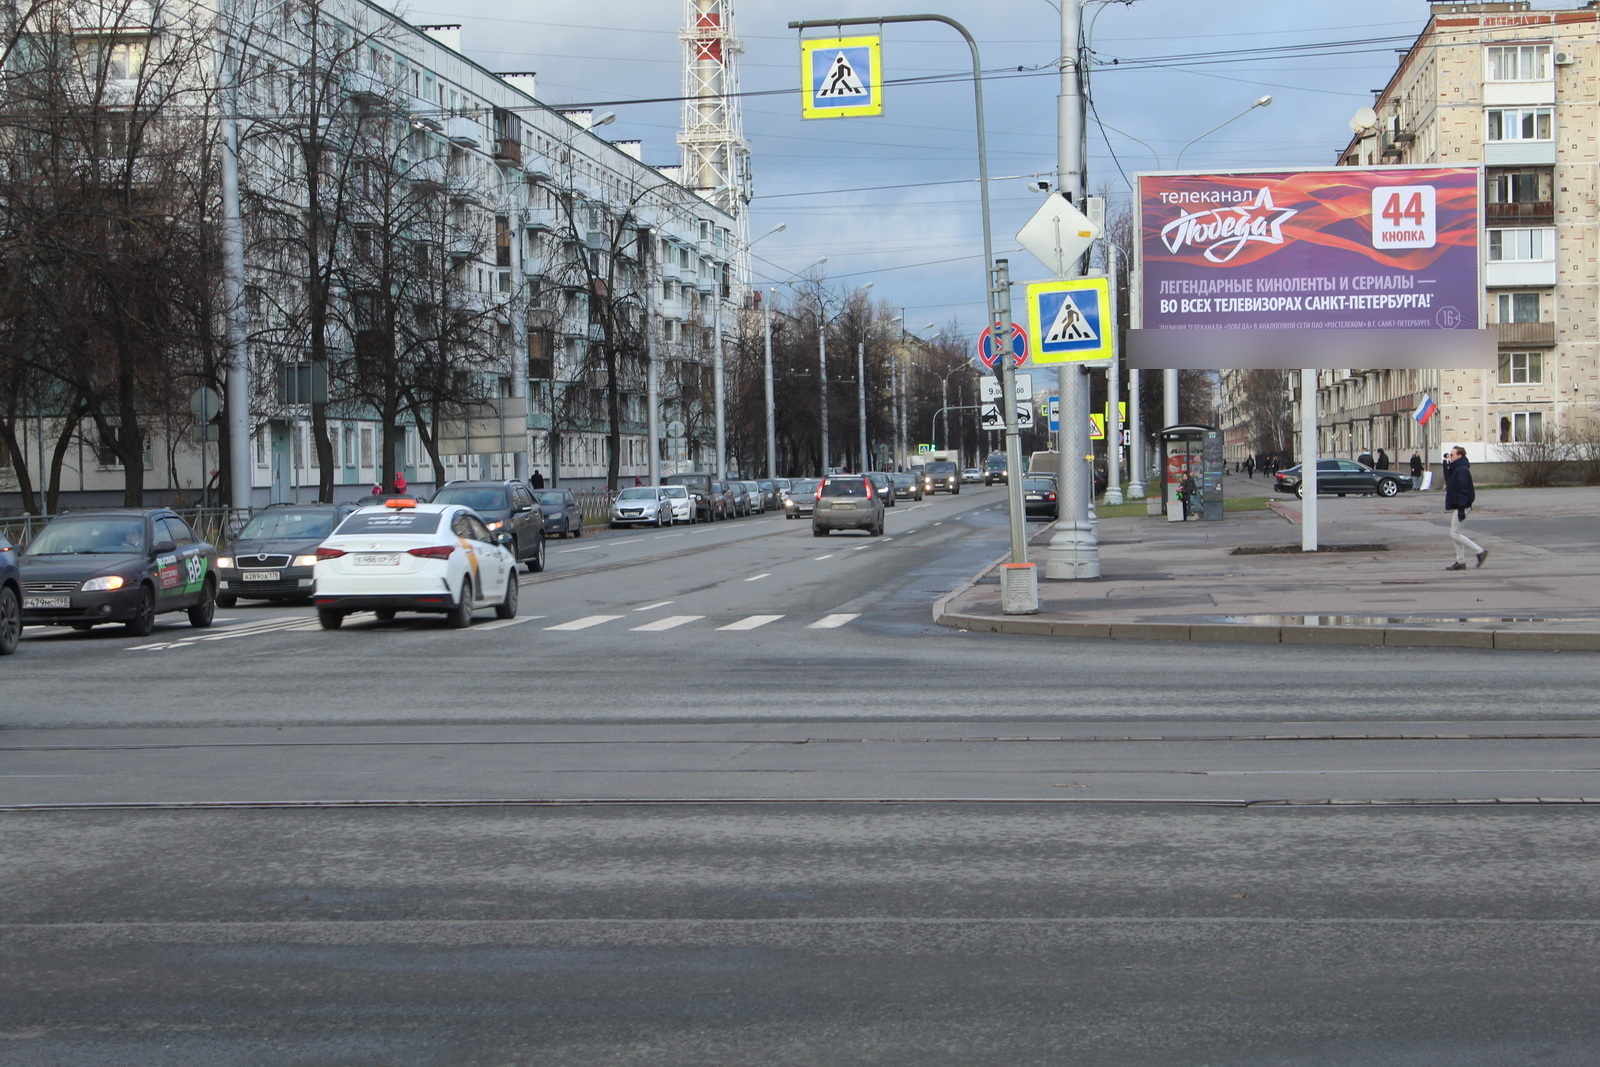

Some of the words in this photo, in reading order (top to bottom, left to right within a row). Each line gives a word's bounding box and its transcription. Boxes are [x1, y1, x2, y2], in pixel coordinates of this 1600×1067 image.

[1160, 190, 1253, 204] телеканал
[1381, 191, 1425, 226] 44
[1161, 202, 1284, 263] Победа
[1381, 230, 1425, 242] КНОПКА
[1160, 279, 1253, 296] ЛЕГЕНДАРНЫЕ
[1256, 277, 1336, 293] КИНОЛЕНТЫ
[1339, 276, 1349, 291] И
[1352, 275, 1414, 291] СЕРИАЛЫ
[1160, 299, 1178, 313] ВО
[1181, 298, 1212, 313] ВСЕХ
[1214, 297, 1302, 312] ТЕЛЕВИЗОРАХ
[1442, 310, 1459, 326] 16+
[56, 597, 68, 605] 198
